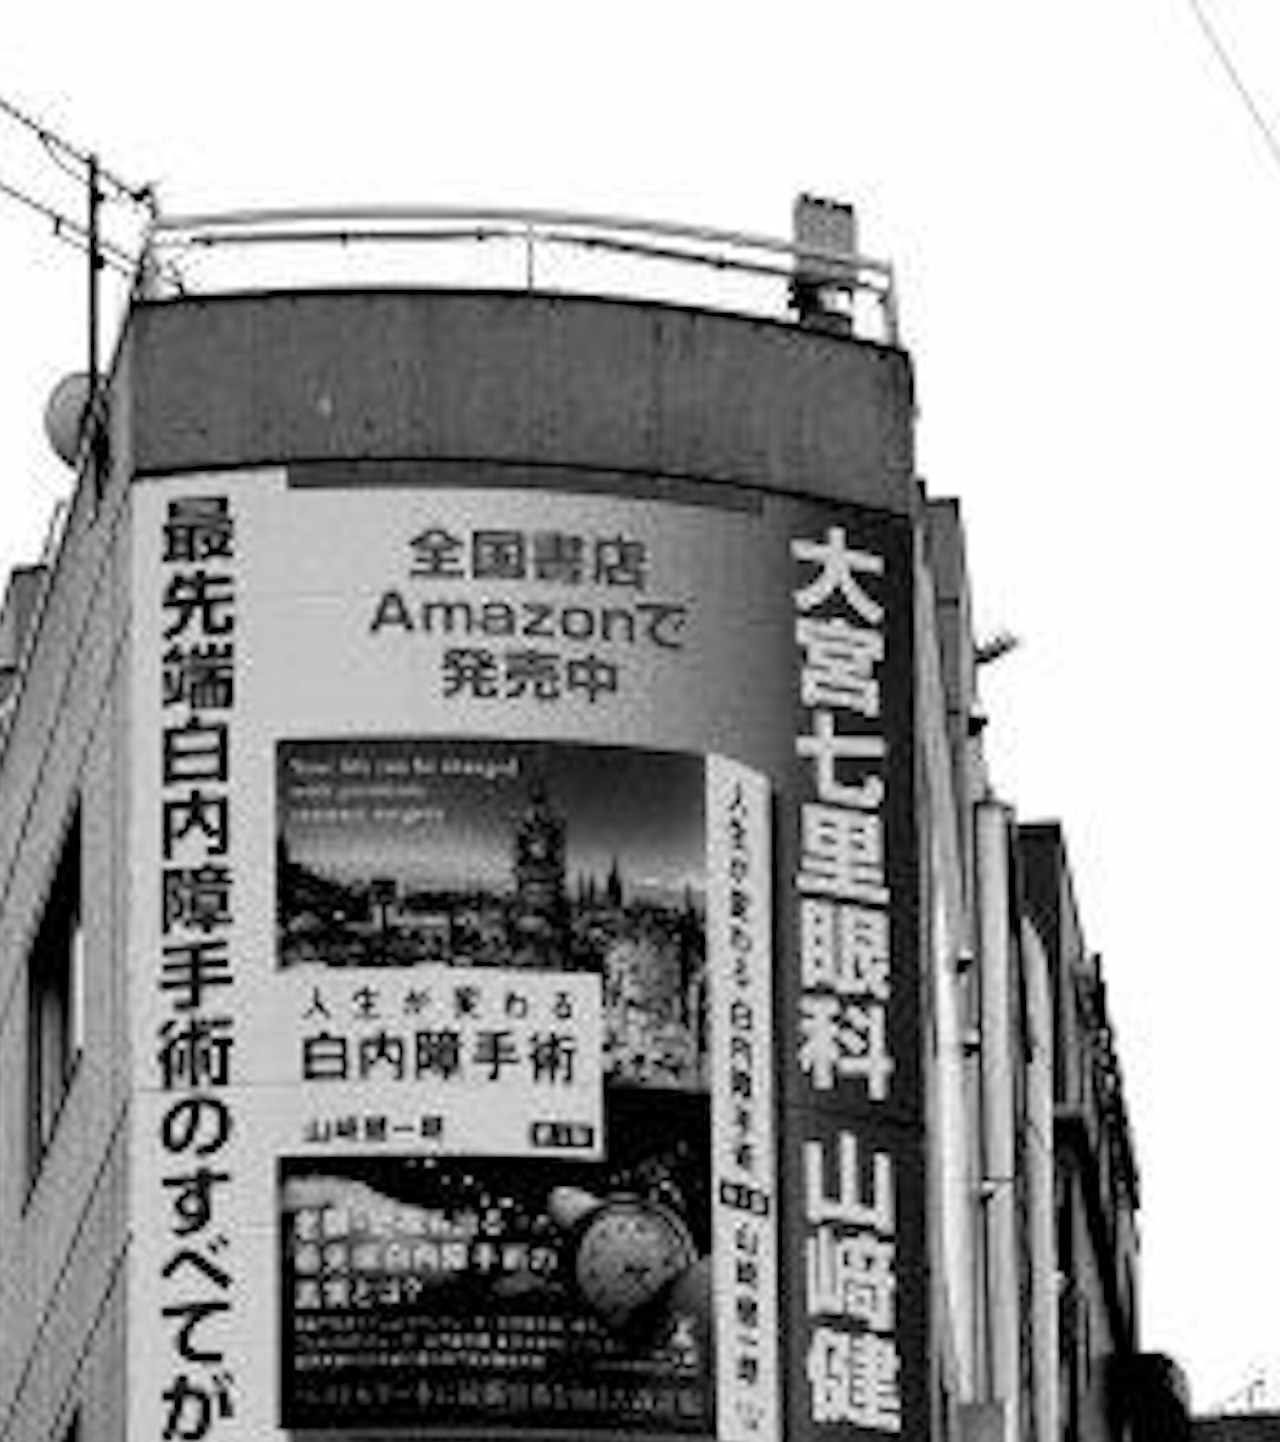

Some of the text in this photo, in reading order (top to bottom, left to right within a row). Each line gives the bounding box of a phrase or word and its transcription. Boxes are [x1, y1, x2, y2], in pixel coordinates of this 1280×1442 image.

[408, 527, 648, 590] 全国書店
[370, 590, 690, 650] Amazonで
[441, 647, 620, 704] 発売中
[791, 525, 893, 1100] 大宮七里眼科
[301, 1029, 577, 1084] 白内障手術
